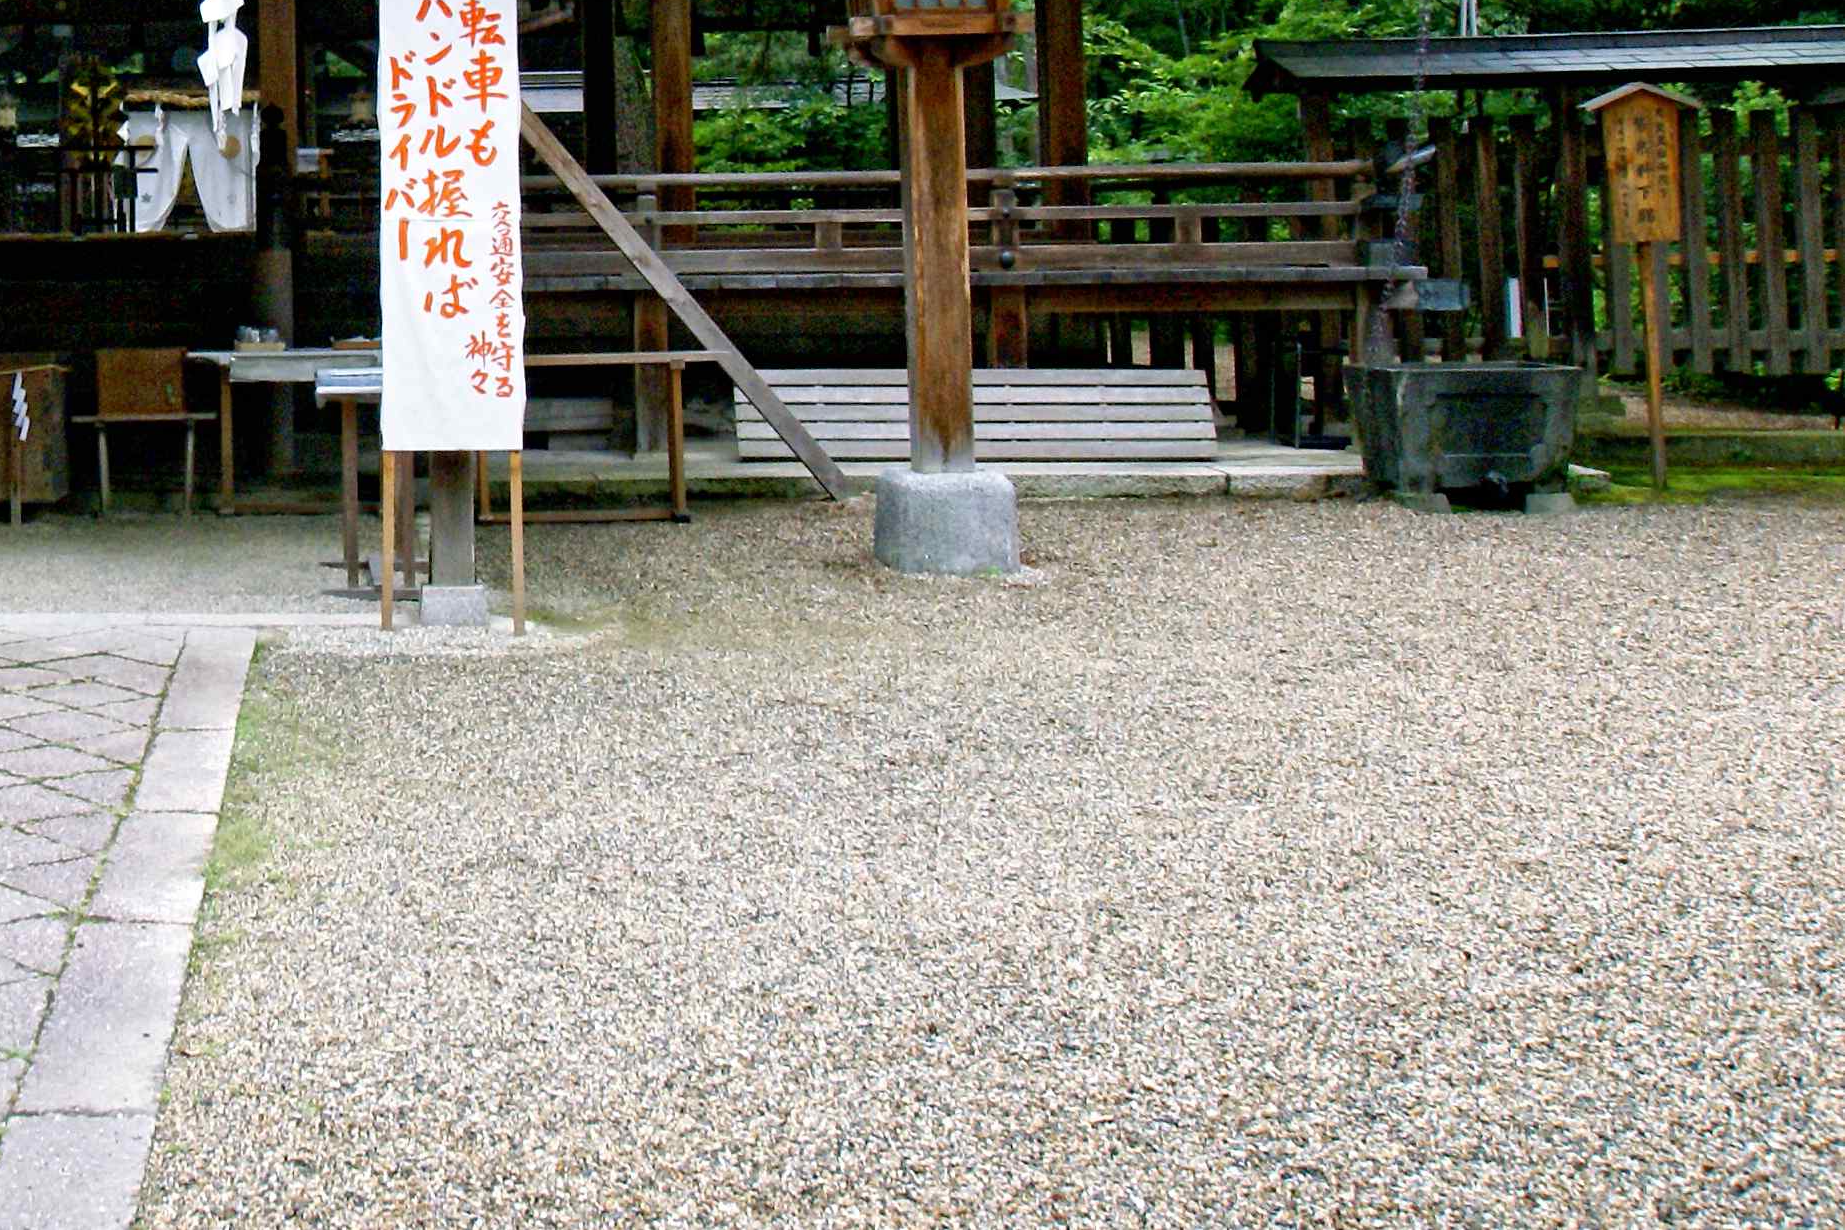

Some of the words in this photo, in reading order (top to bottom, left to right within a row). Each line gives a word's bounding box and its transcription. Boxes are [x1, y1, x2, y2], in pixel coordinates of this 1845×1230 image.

[384, 51, 416, 261] ドライバー
[465, 332, 492, 397] 神々
[488, 201, 515, 398] 交通安全を守る
